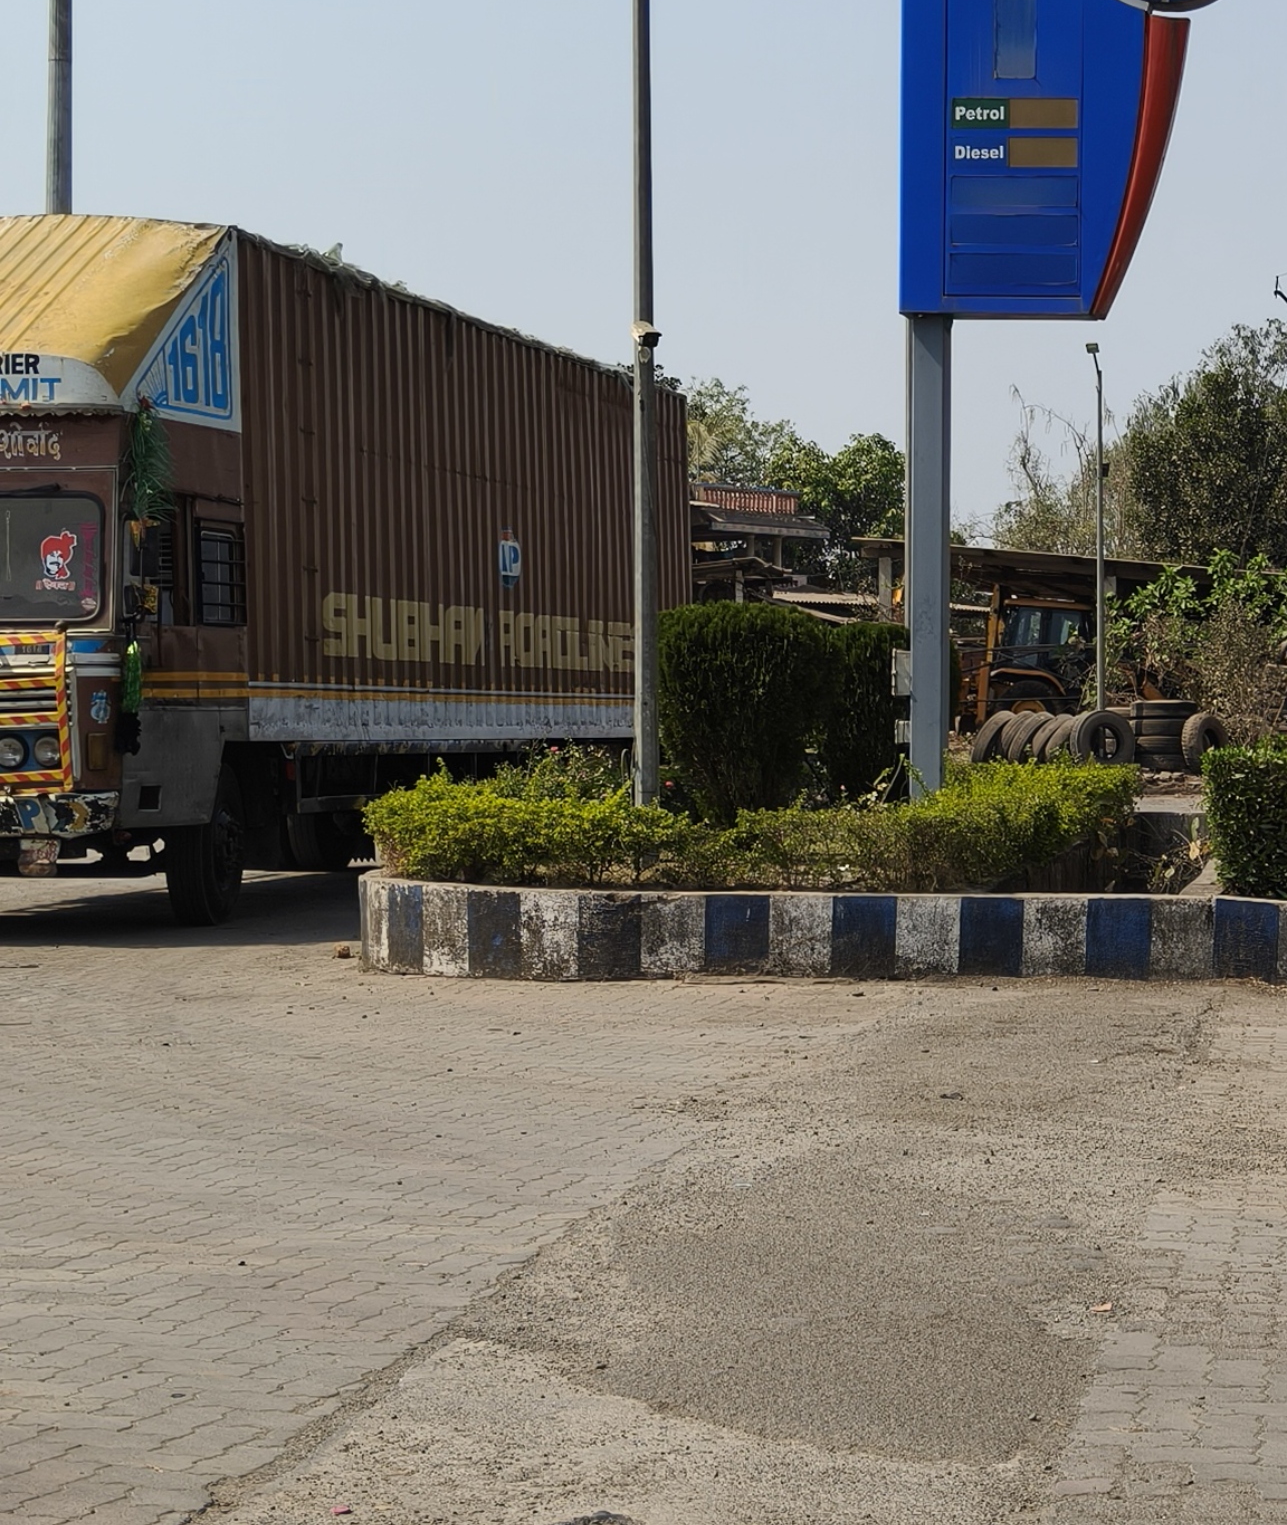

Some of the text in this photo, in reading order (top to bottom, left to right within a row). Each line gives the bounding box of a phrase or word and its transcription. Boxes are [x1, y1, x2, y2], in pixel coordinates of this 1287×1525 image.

[955, 106, 1005, 121] Petrol
[954, 145, 1004, 160] Diesel
[168, 269, 229, 410] 1618
[322, 591, 635, 673] SHUBHAM ROADLINE
